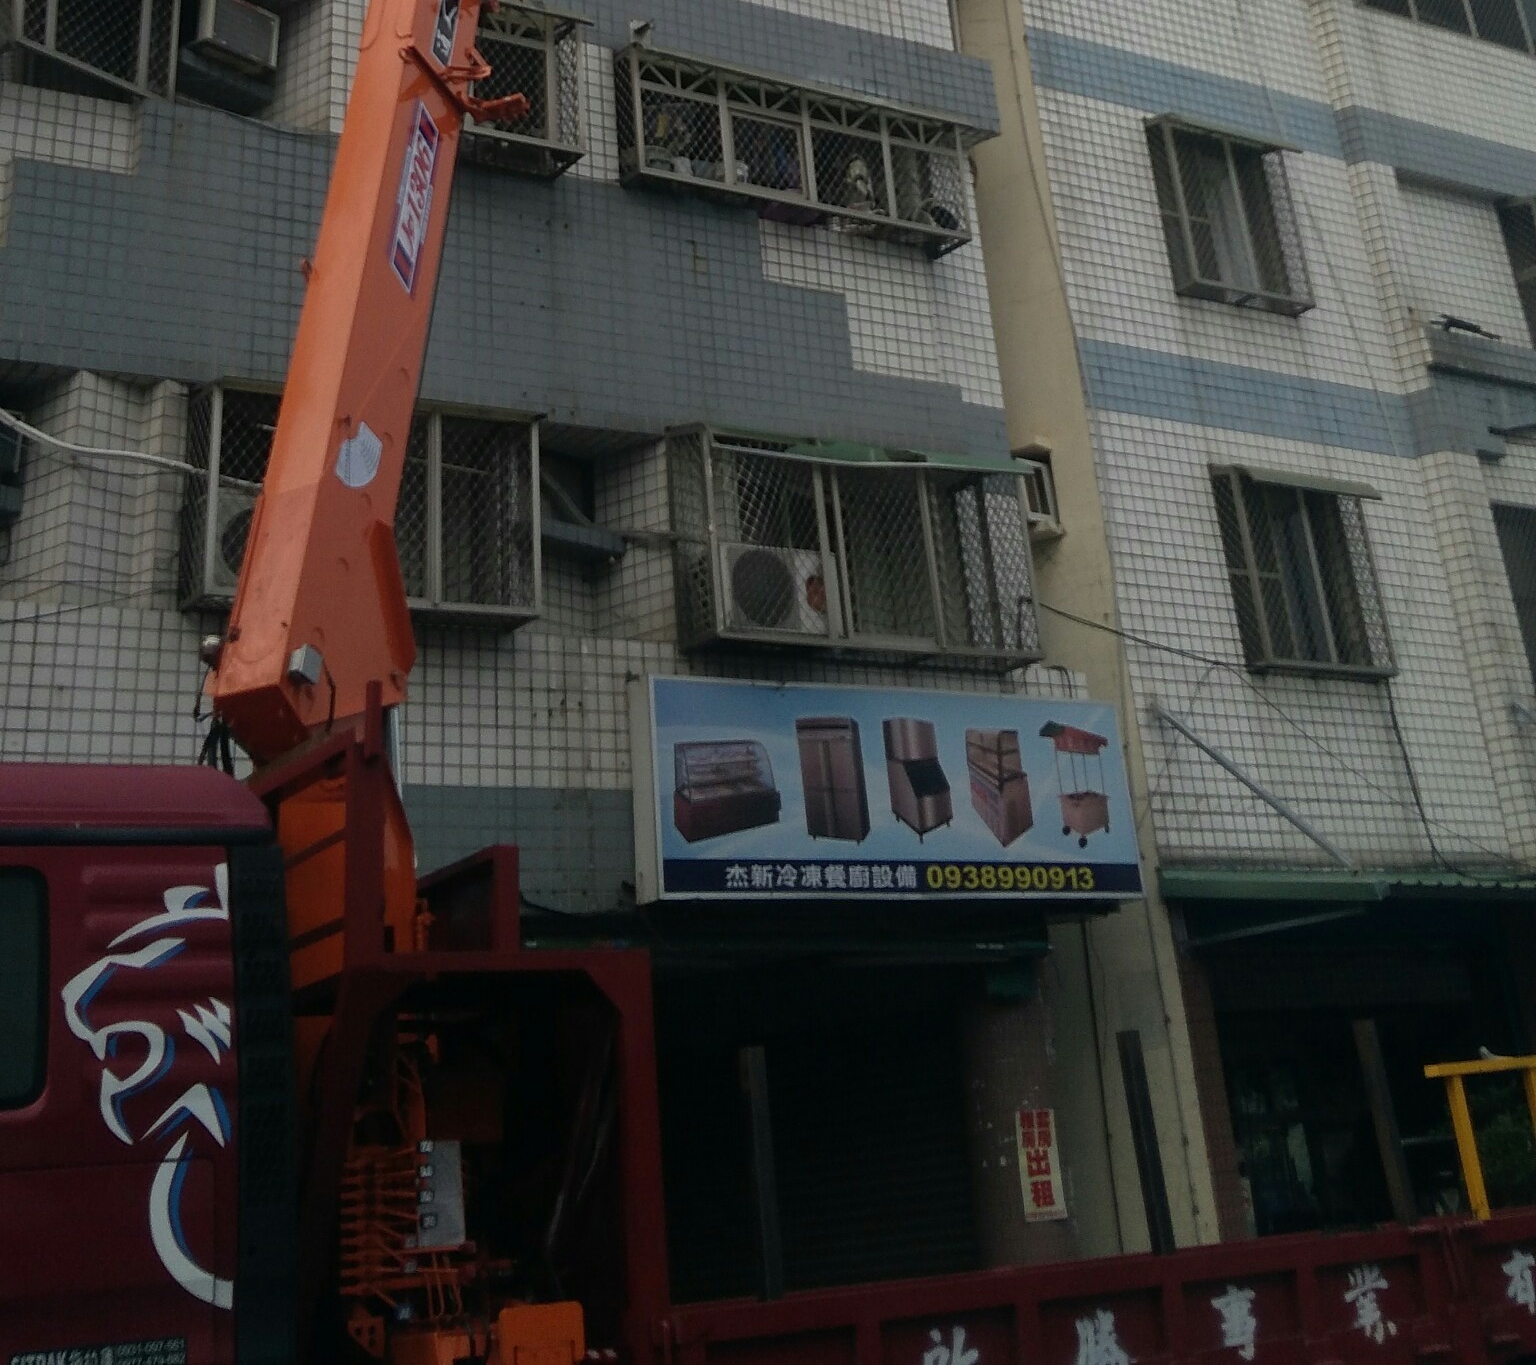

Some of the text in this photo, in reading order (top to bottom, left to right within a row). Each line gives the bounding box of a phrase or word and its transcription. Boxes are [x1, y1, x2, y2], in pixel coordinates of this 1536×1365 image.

[724, 863, 1095, 890] 杰新冷凍餐廚設備 0938990913
[1026, 1149, 1055, 1207] 出租
